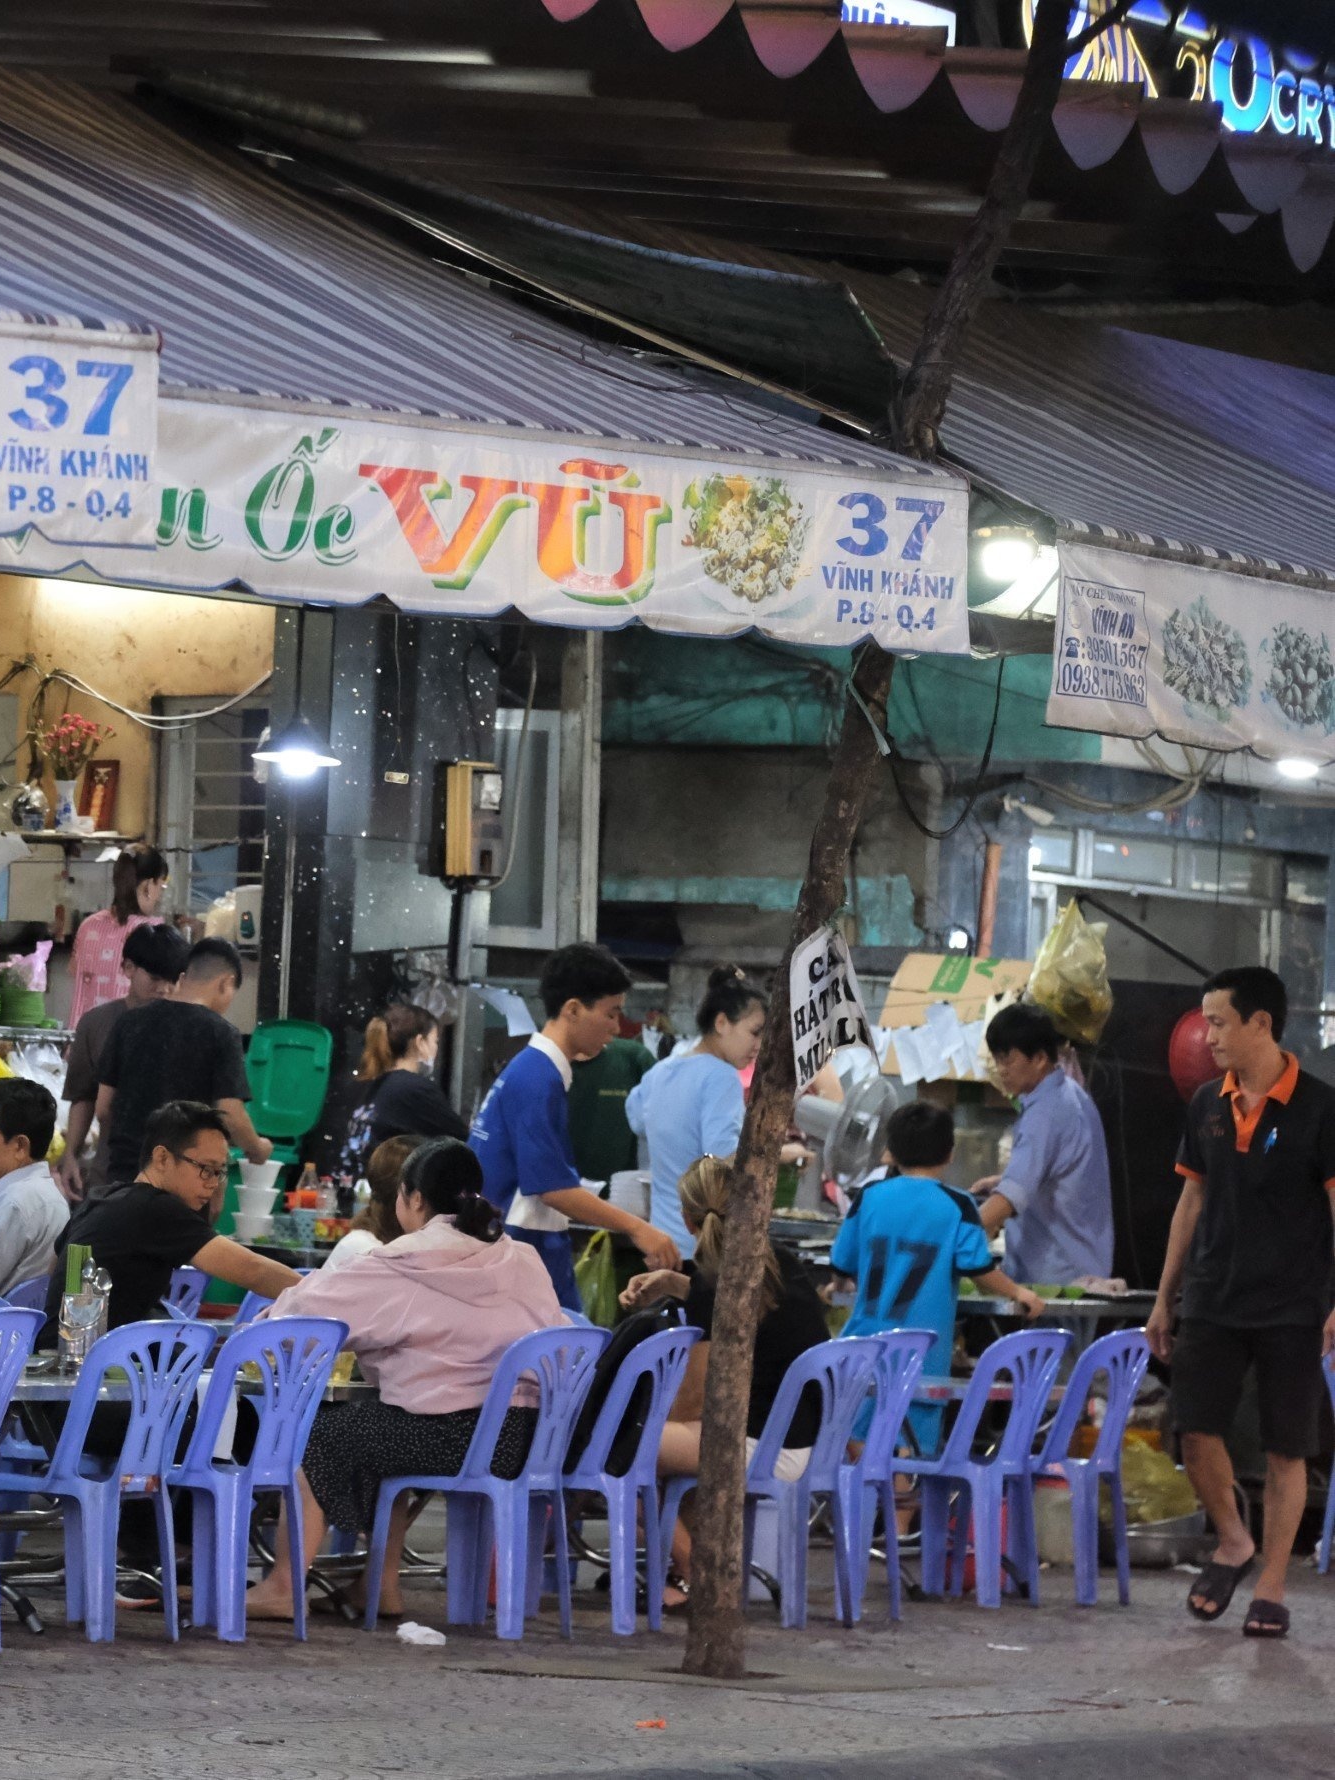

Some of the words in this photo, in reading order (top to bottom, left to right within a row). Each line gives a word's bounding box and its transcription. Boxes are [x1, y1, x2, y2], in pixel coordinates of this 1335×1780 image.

[8, 354, 134, 436] 37
[60, 444, 149, 482] KHÁNH
[7, 484, 57, 514] P.8
[244, 425, 361, 567] Ốc
[358, 456, 674, 607] VŨ
[835, 492, 946, 561] 37
[821, 560, 874, 592] VĨNH
[881, 567, 955, 600] KHÁNH
[836, 598, 875, 626] P.8
[1062, 662, 1146, 703] 0938.773.663
[865, 1236, 941, 1320] 17
